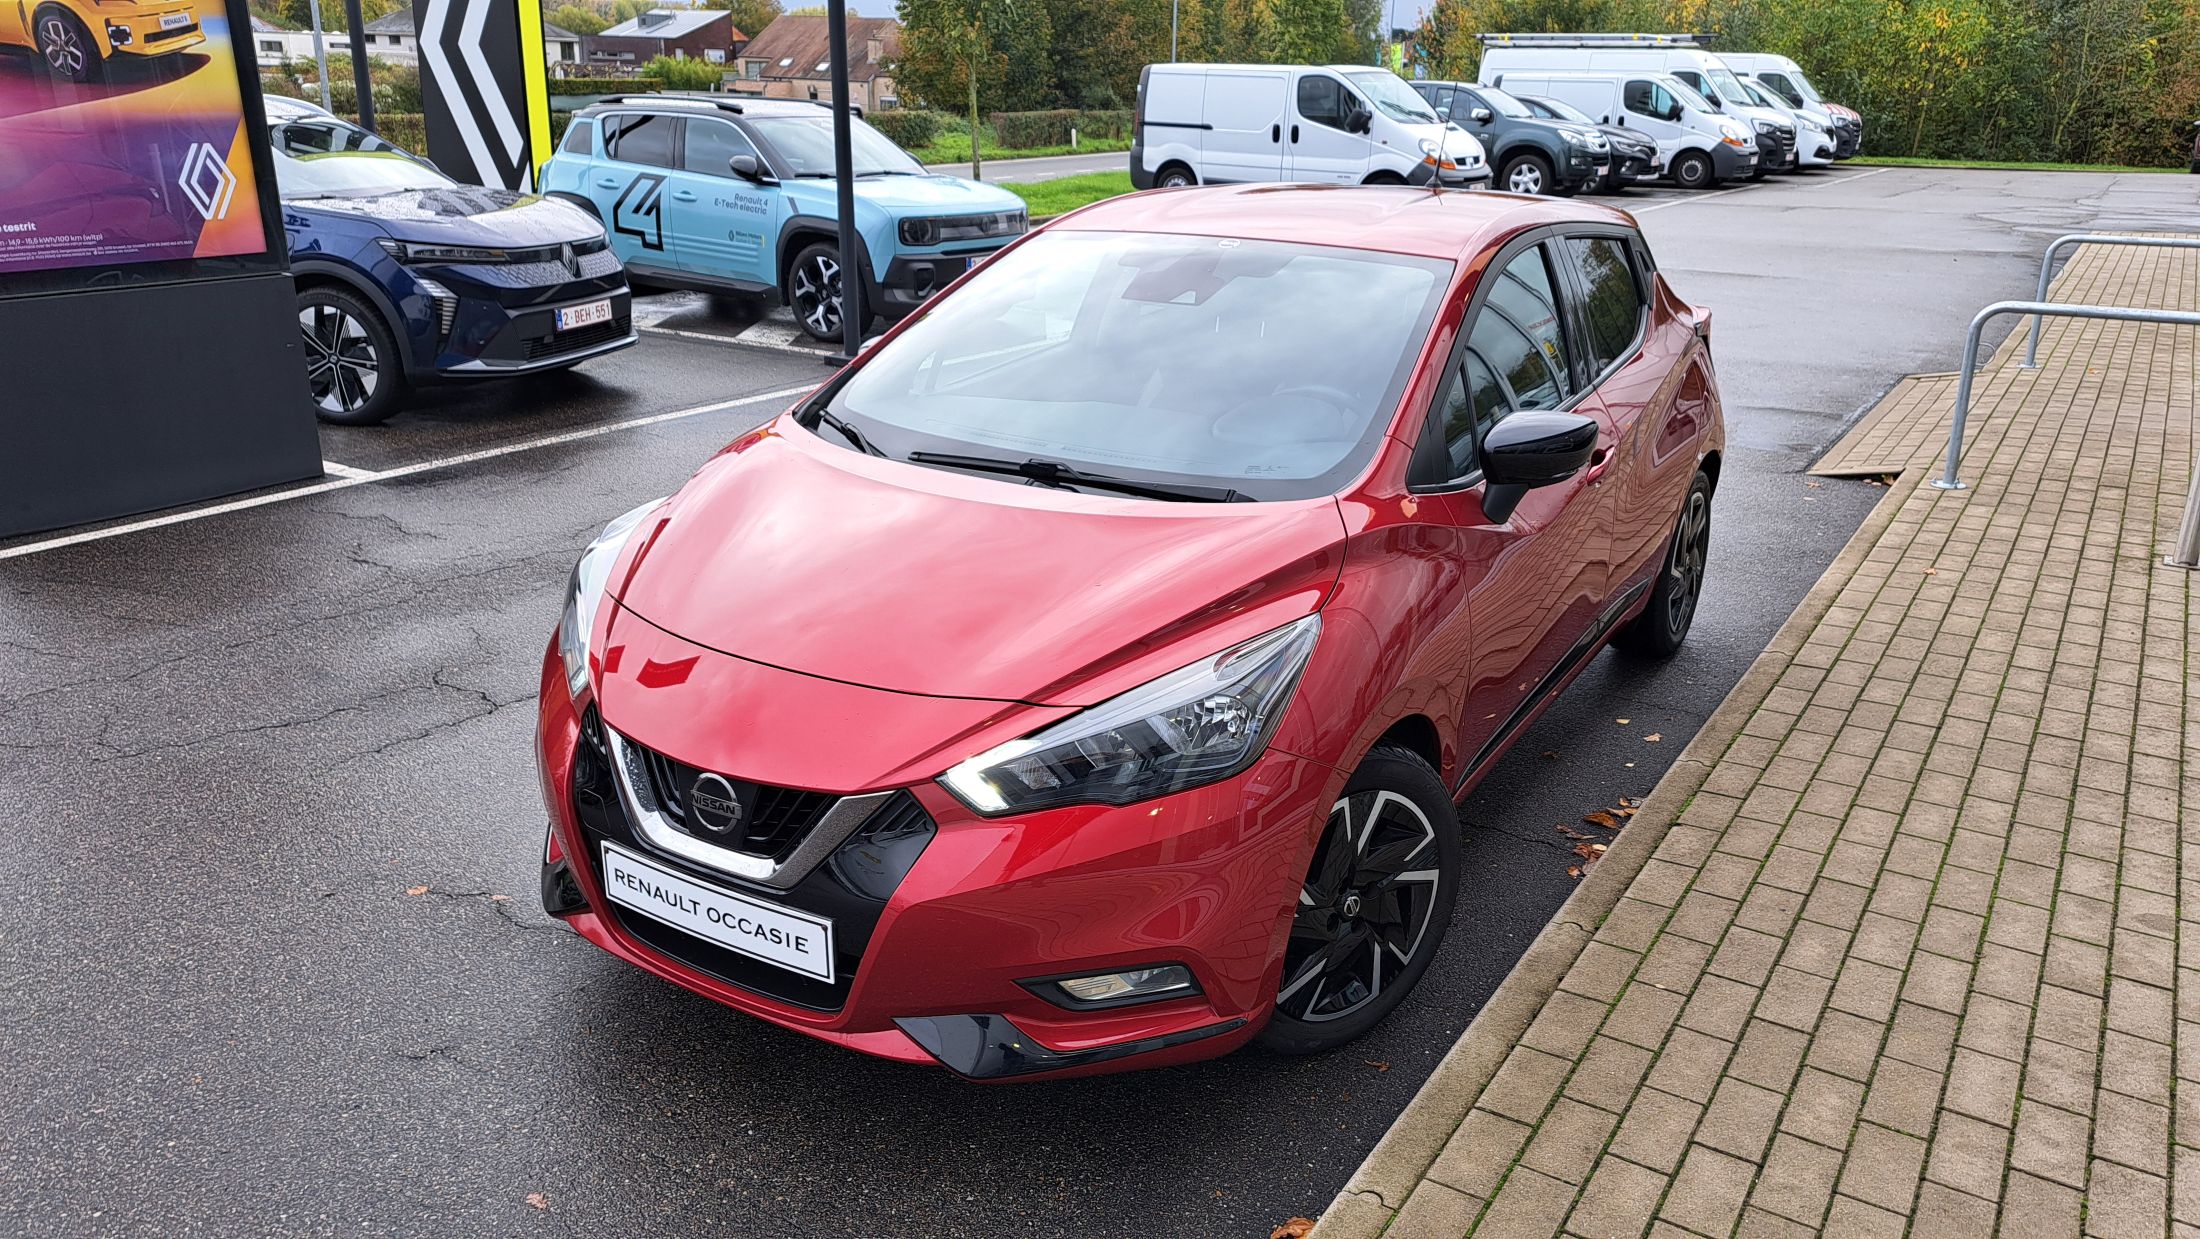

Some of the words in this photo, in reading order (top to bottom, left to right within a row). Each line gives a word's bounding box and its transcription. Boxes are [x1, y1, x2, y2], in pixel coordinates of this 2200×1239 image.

[714, 198, 738, 210] E-Tech
[740, 204, 767, 215] electric
[735, 193, 762, 206] Renault
[3, 221, 36, 232] testrit
[692, 792, 735, 815] NISSAN
[614, 868, 700, 916] RENAULT
[706, 907, 809, 954] OCCASIE
